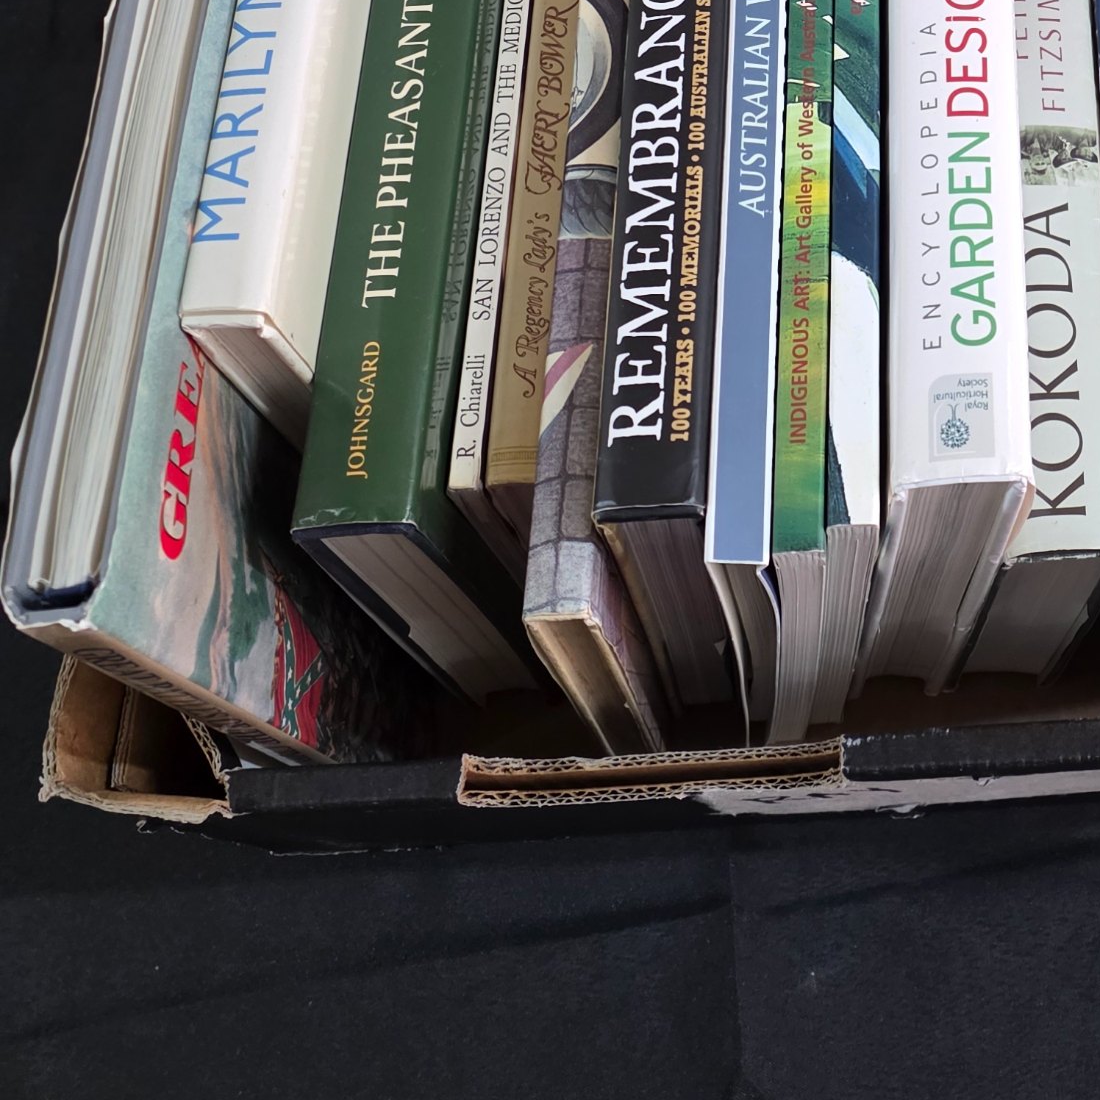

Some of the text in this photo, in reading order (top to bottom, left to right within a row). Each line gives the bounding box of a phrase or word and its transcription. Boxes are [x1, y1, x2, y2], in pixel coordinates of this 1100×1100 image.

[496, 64, 517, 104] THE
[691, 11, 712, 118] AUSTRALIAN
[738, 16, 771, 218] AUSTRALIAN
[798, 67, 815, 137] Western
[491, 112, 512, 156] AND
[688, 121, 707, 151] 100
[796, 142, 814, 161] of
[478, 167, 507, 266] LORENZO
[795, 166, 817, 229] Gallery
[918, 23, 942, 350] ENCYCLOPEDIA
[522, 212, 555, 273] Lady's
[681, 166, 703, 287] MEMORIALS
[795, 235, 811, 263] Art
[947, 131, 997, 347] GARDEN
[361, 221, 405, 308] THE
[472, 278, 495, 321] SAN
[516, 276, 551, 358] Regency
[679, 290, 697, 323] 100
[460, 353, 487, 428] Chiarelli
[513, 363, 537, 398] A
[674, 338, 694, 408] YEARS
[790, 317, 810, 445] INDIGENOUS
[956, 377, 989, 388] Society
[1023, 202, 1087, 520] KOKODA
[346, 341, 381, 479] JOHNSGARD
[670, 409, 691, 443] 100
[933, 390, 989, 404] Horticultural
[965, 401, 989, 412] Royal
[456, 439, 477, 459] R.
